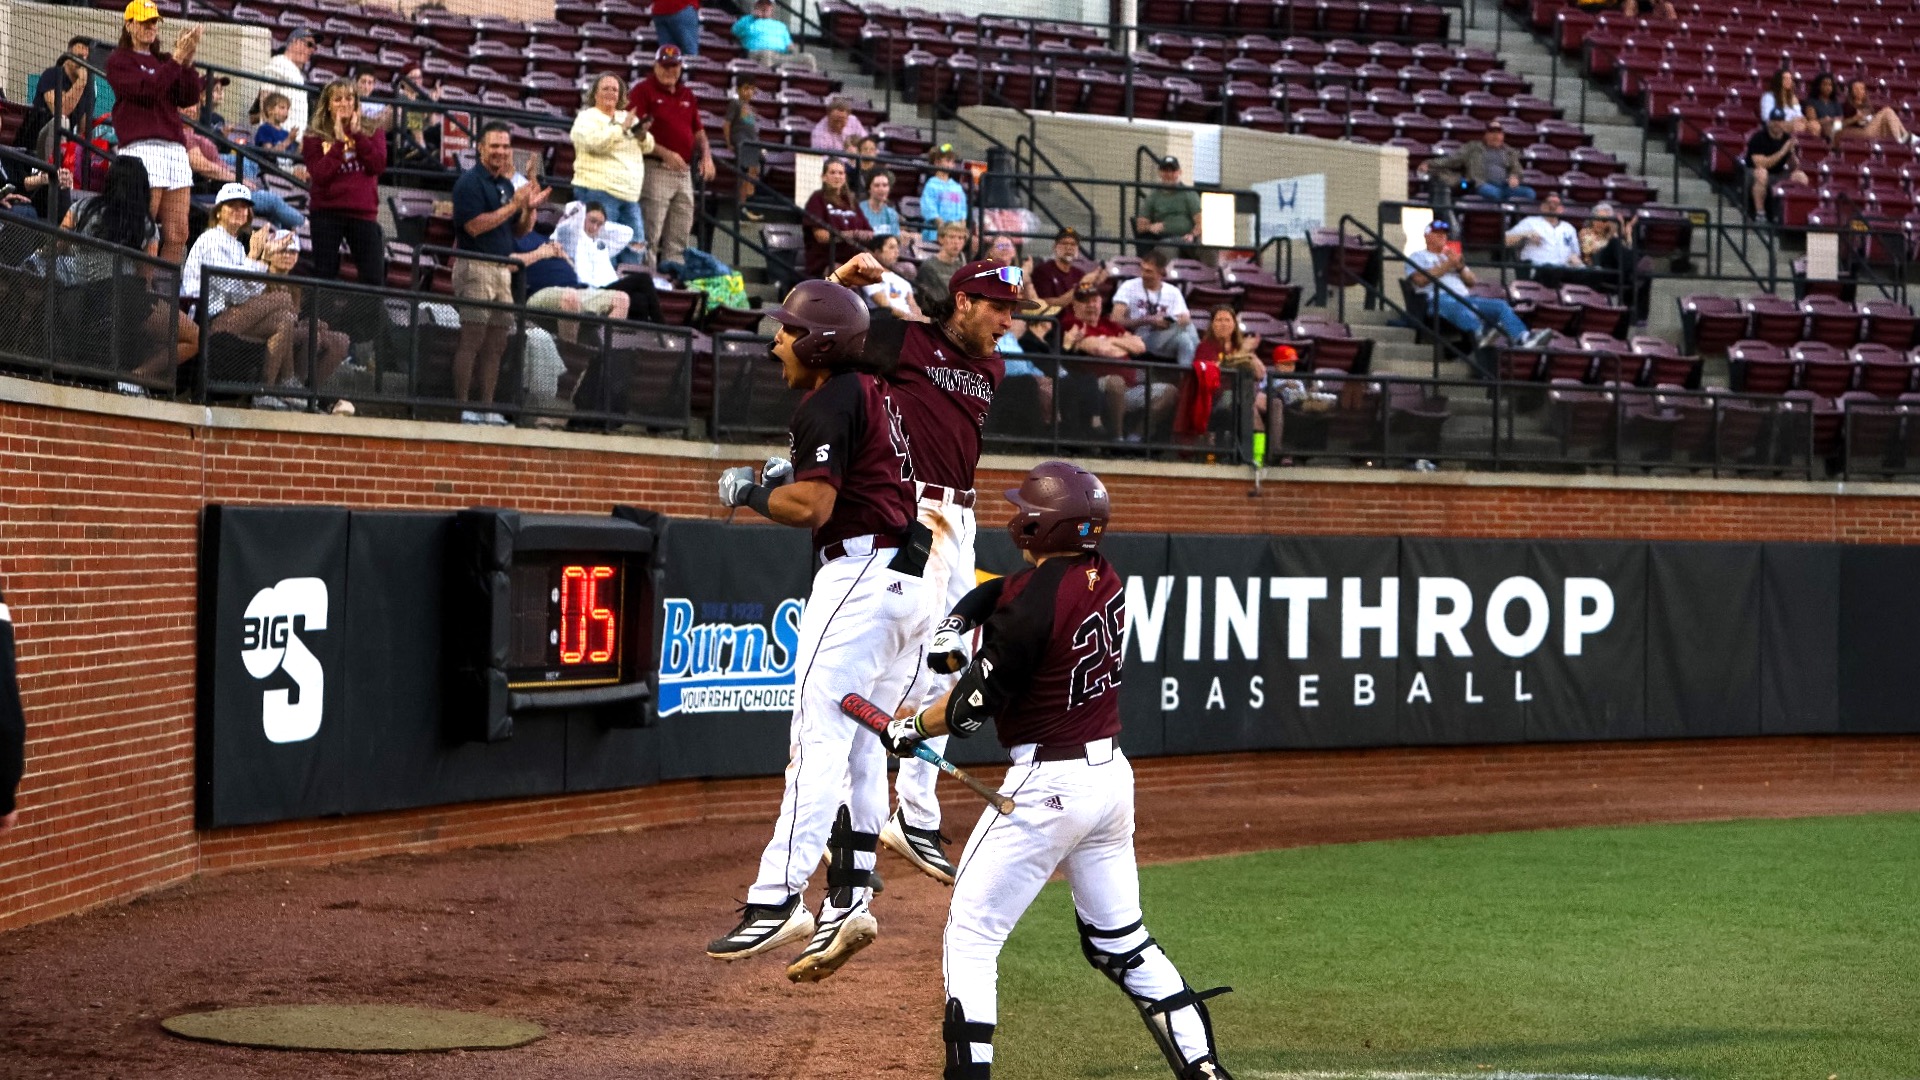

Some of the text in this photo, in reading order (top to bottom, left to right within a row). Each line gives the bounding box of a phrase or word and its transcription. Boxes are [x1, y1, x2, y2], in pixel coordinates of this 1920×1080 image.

[240, 615, 289, 651] BIG
[1122, 575, 1615, 663] WINTHROP
[1066, 587, 1126, 711] 25
[682, 689, 796, 710] YOUR RGHT CHOICE
[1161, 671, 1532, 712] BASEBALL
